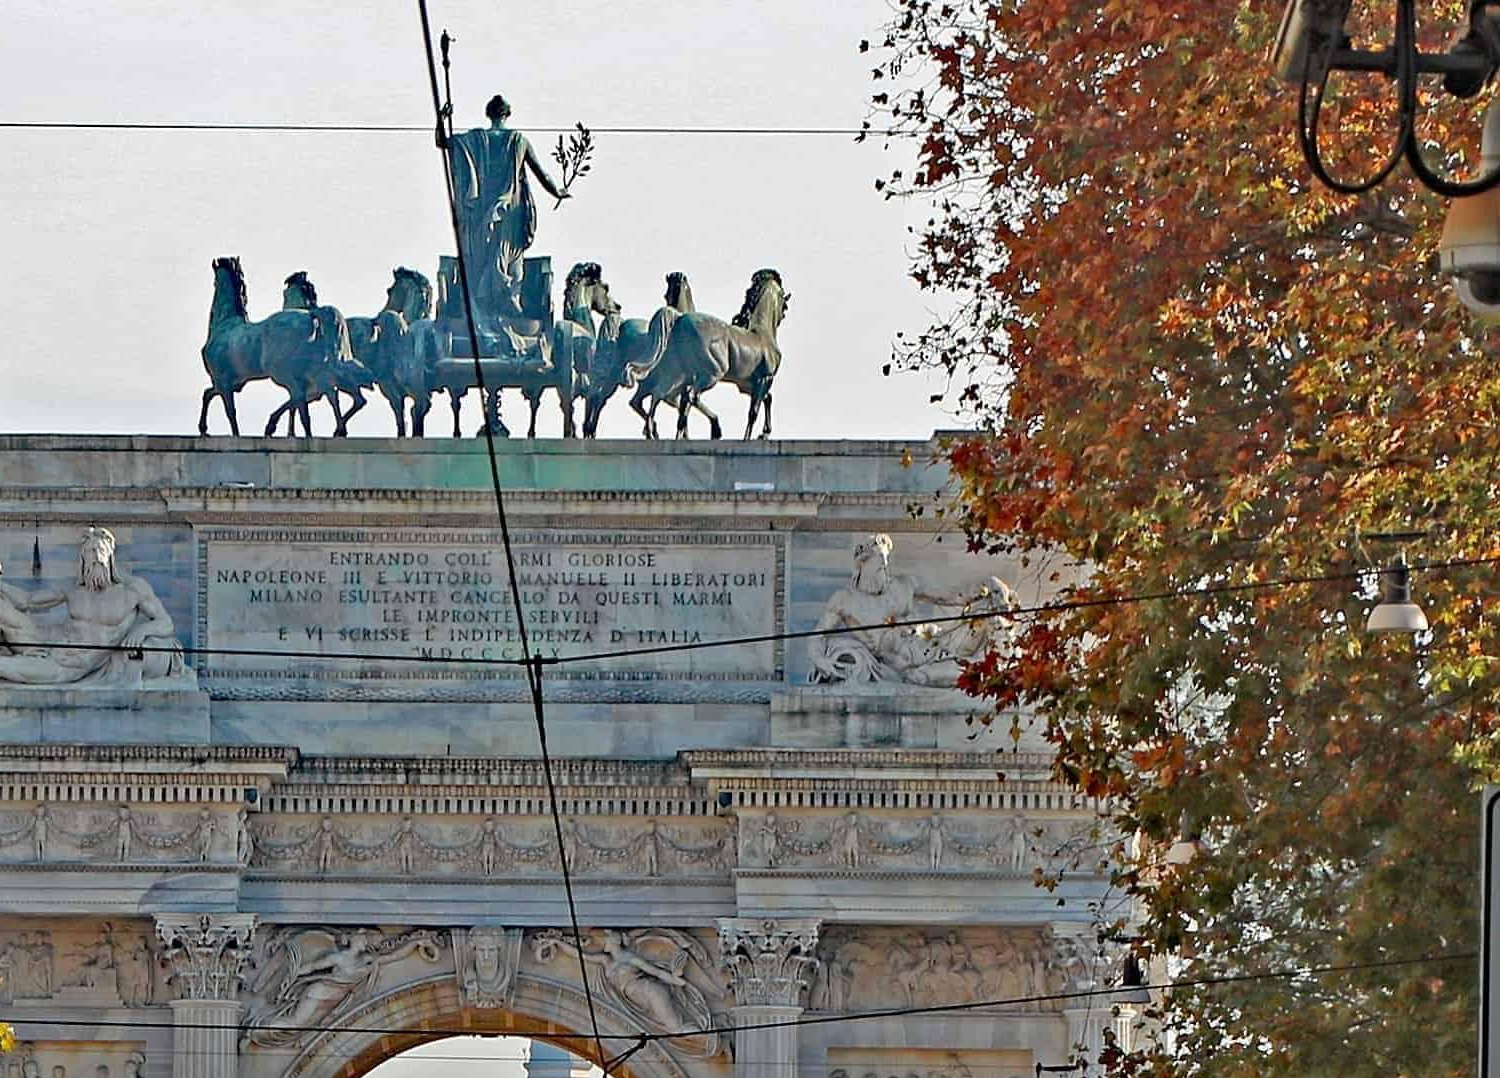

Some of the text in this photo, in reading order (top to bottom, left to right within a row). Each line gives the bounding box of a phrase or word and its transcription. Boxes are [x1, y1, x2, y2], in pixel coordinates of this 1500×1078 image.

[330, 552, 429, 566] ENTRANDO
[568, 552, 657, 567] GLORIOSE
[217, 570, 327, 585] NAPOLEONE
[343, 570, 361, 585] III
[377, 570, 387, 585] E
[403, 571, 493, 586] VITTORIO
[623, 573, 636, 586] II
[652, 573, 766, 587] LIBERATORI
[250, 590, 323, 604] MILANO
[339, 590, 438, 604] ESULTANTE
[558, 591, 582, 605] DA
[595, 591, 659, 606] QUESTI
[672, 591, 733, 606] MARMI
[382, 609, 599, 625] LE IMPRONTE SERVILI
[278, 626, 289, 641] E
[306, 627, 323, 642] VI
[339, 627, 410, 642] SCRISSE
[639, 629, 702, 644] ITALIA
